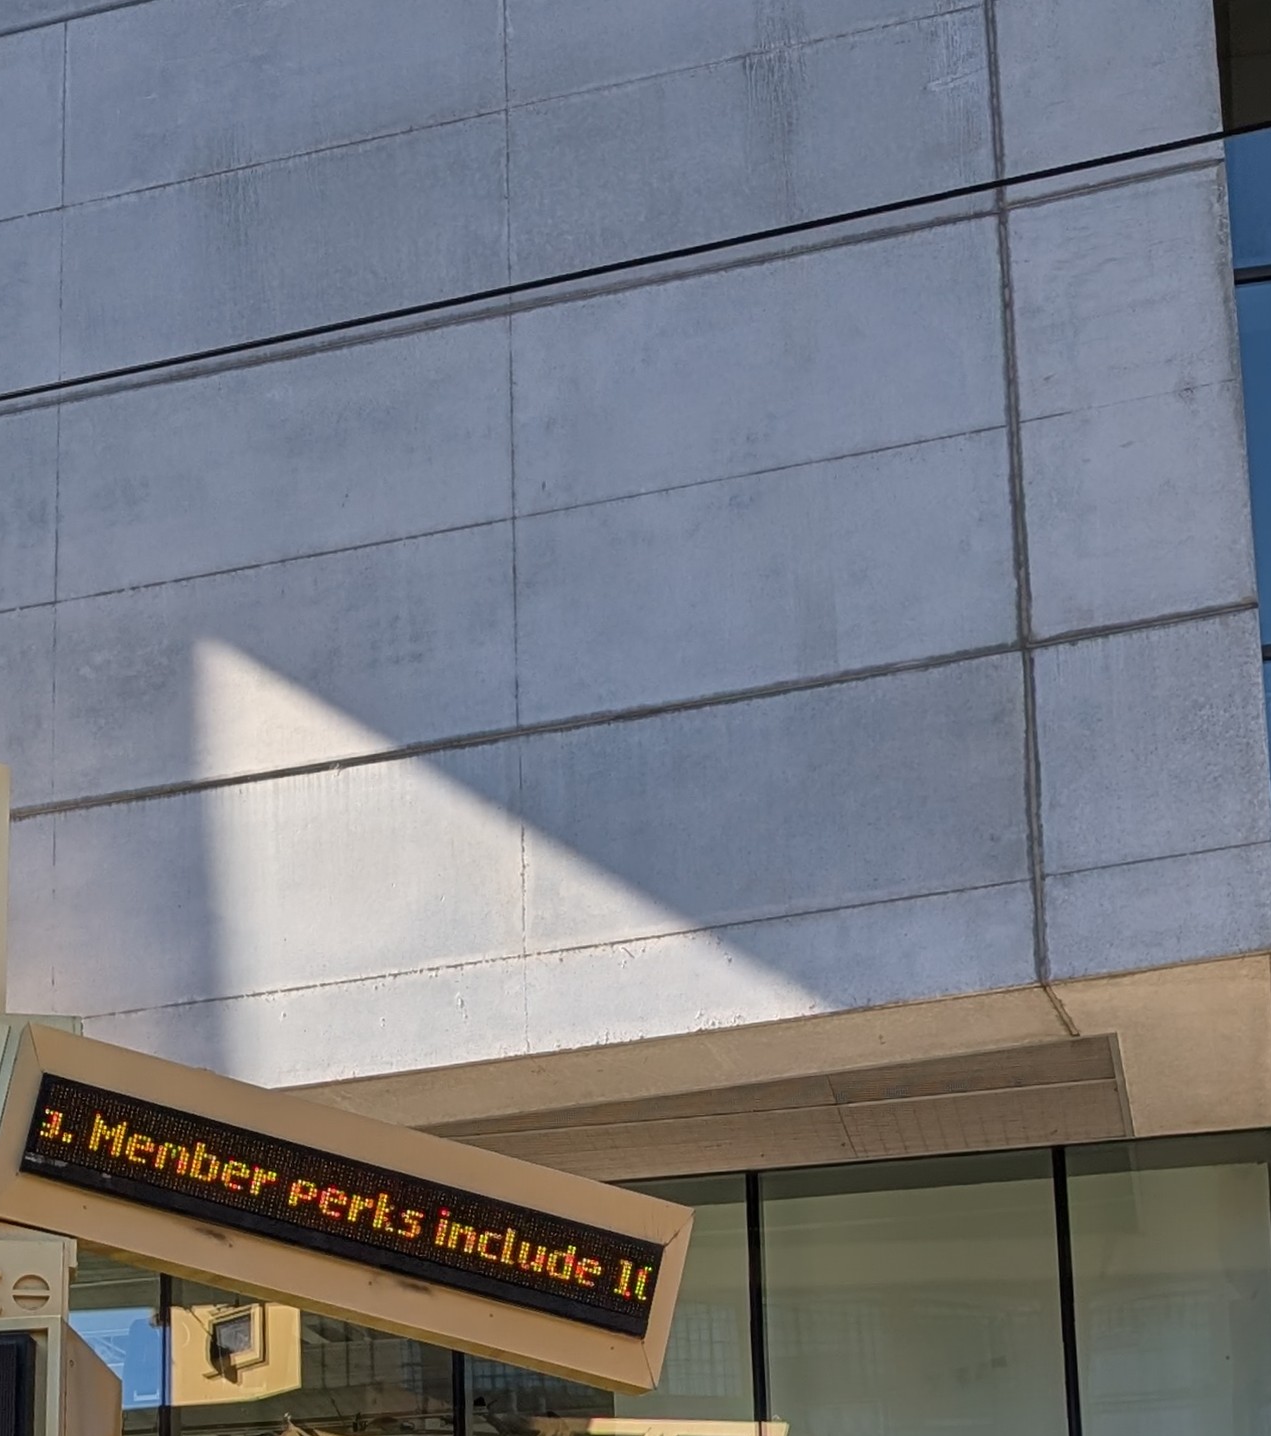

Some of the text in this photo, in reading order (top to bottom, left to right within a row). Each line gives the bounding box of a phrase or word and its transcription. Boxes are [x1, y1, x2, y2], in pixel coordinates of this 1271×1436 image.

[89, 1112, 277, 1195] Member
[288, 1179, 424, 1239] perks
[435, 1207, 601, 1287] include
